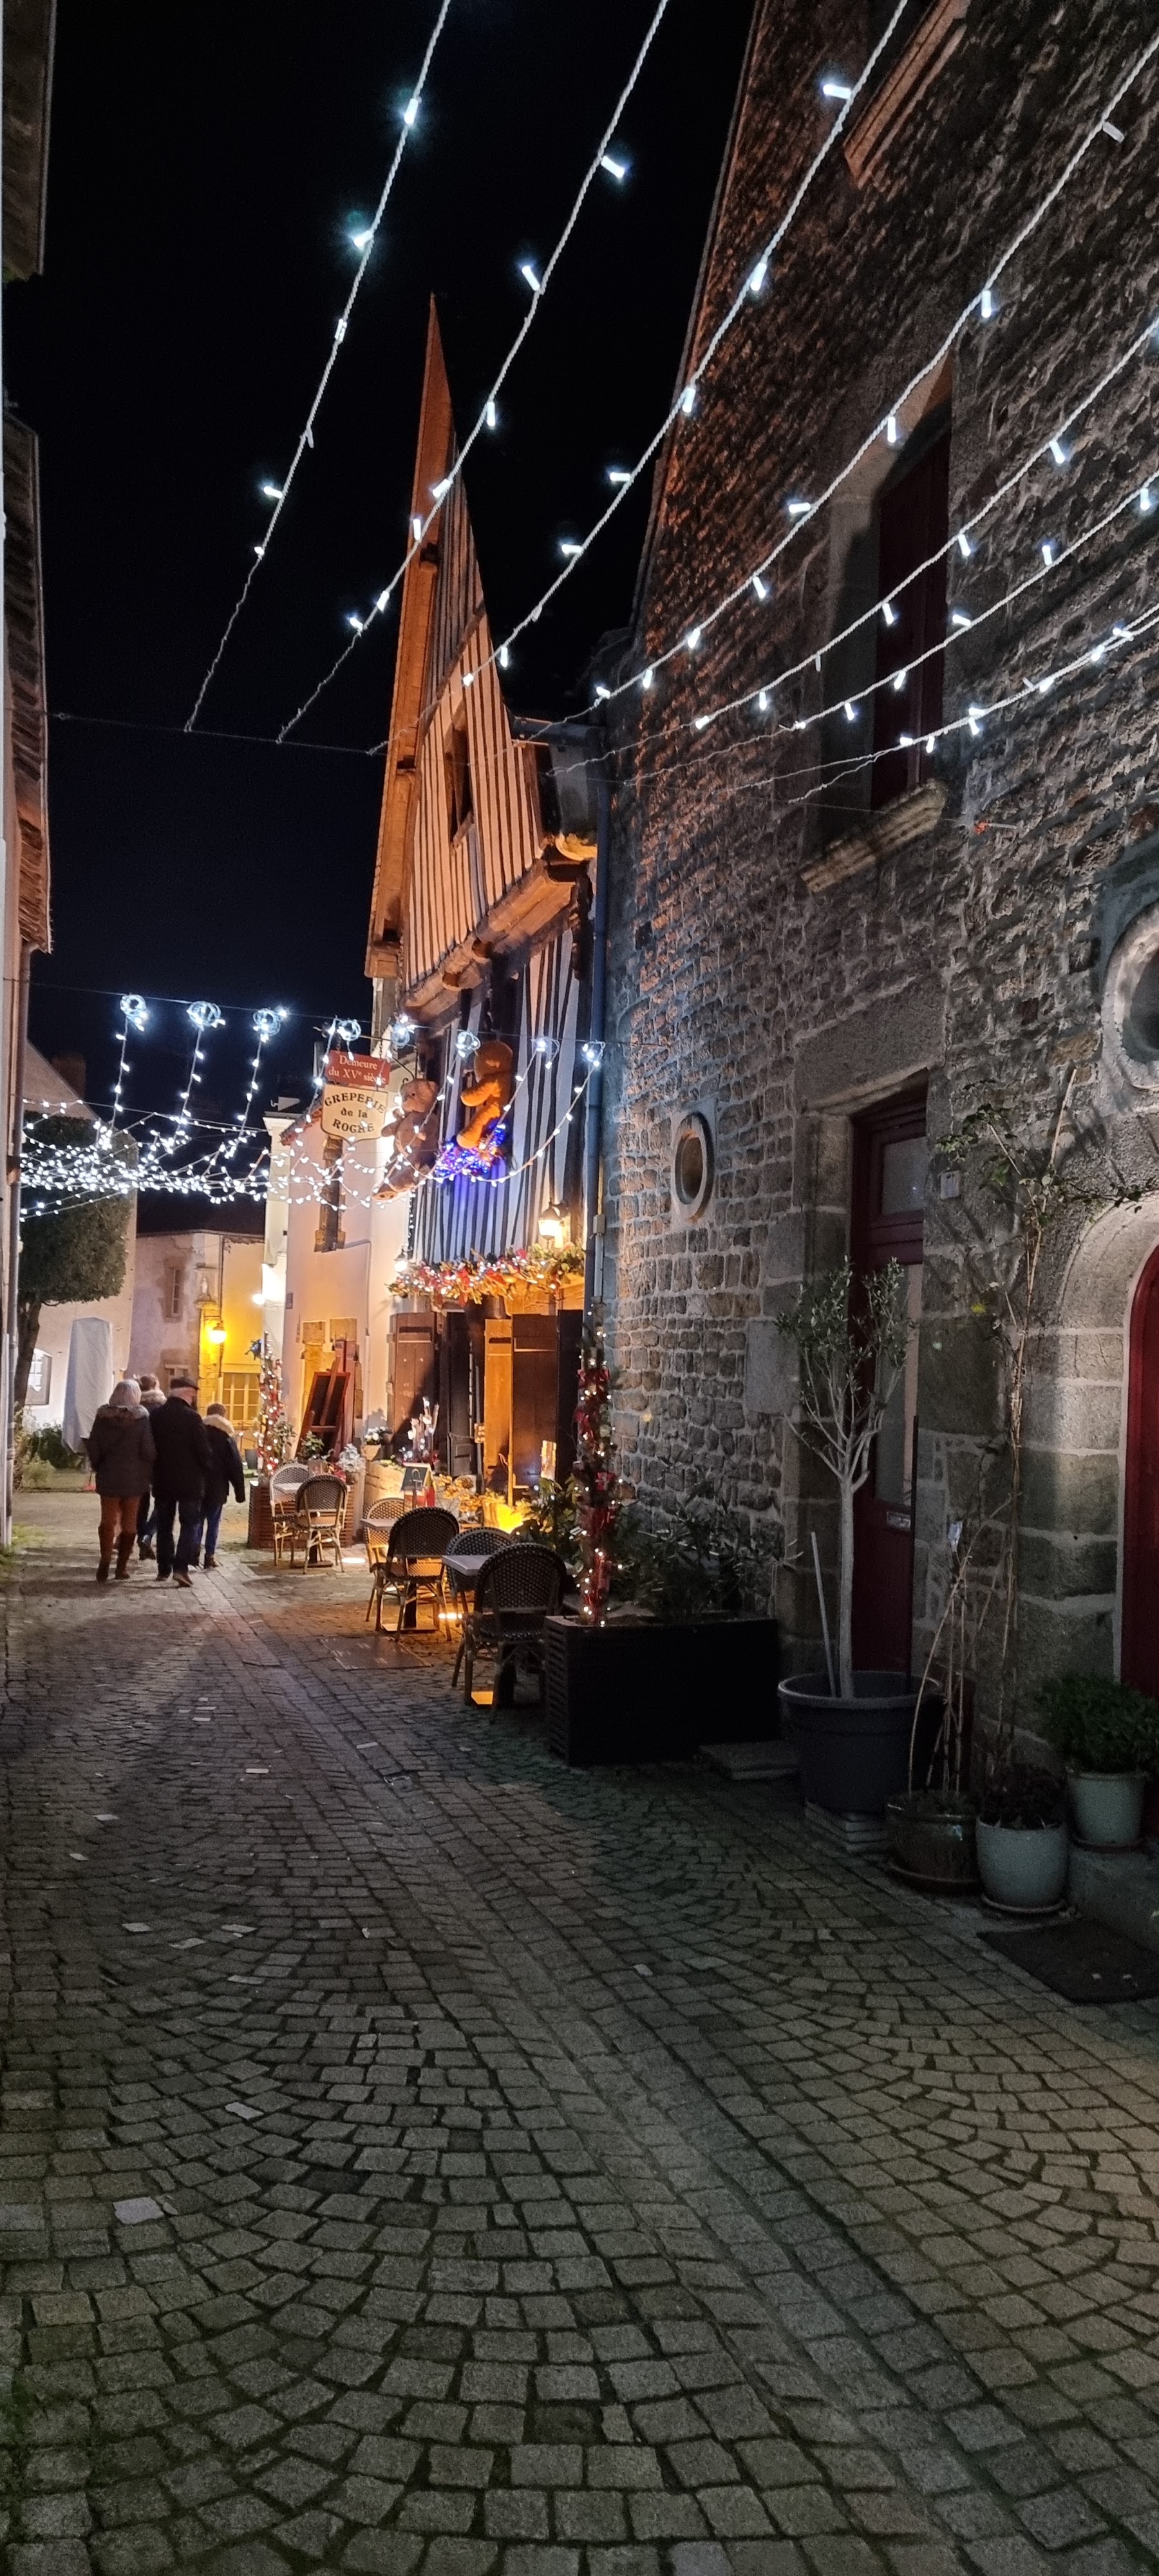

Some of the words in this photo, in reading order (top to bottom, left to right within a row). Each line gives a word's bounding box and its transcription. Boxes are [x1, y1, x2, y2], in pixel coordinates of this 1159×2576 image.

[339, 1055, 378, 1070] Demeure
[328, 1066, 339, 1077] du
[341, 1108, 353, 1117] de
[358, 1109, 368, 1118] la
